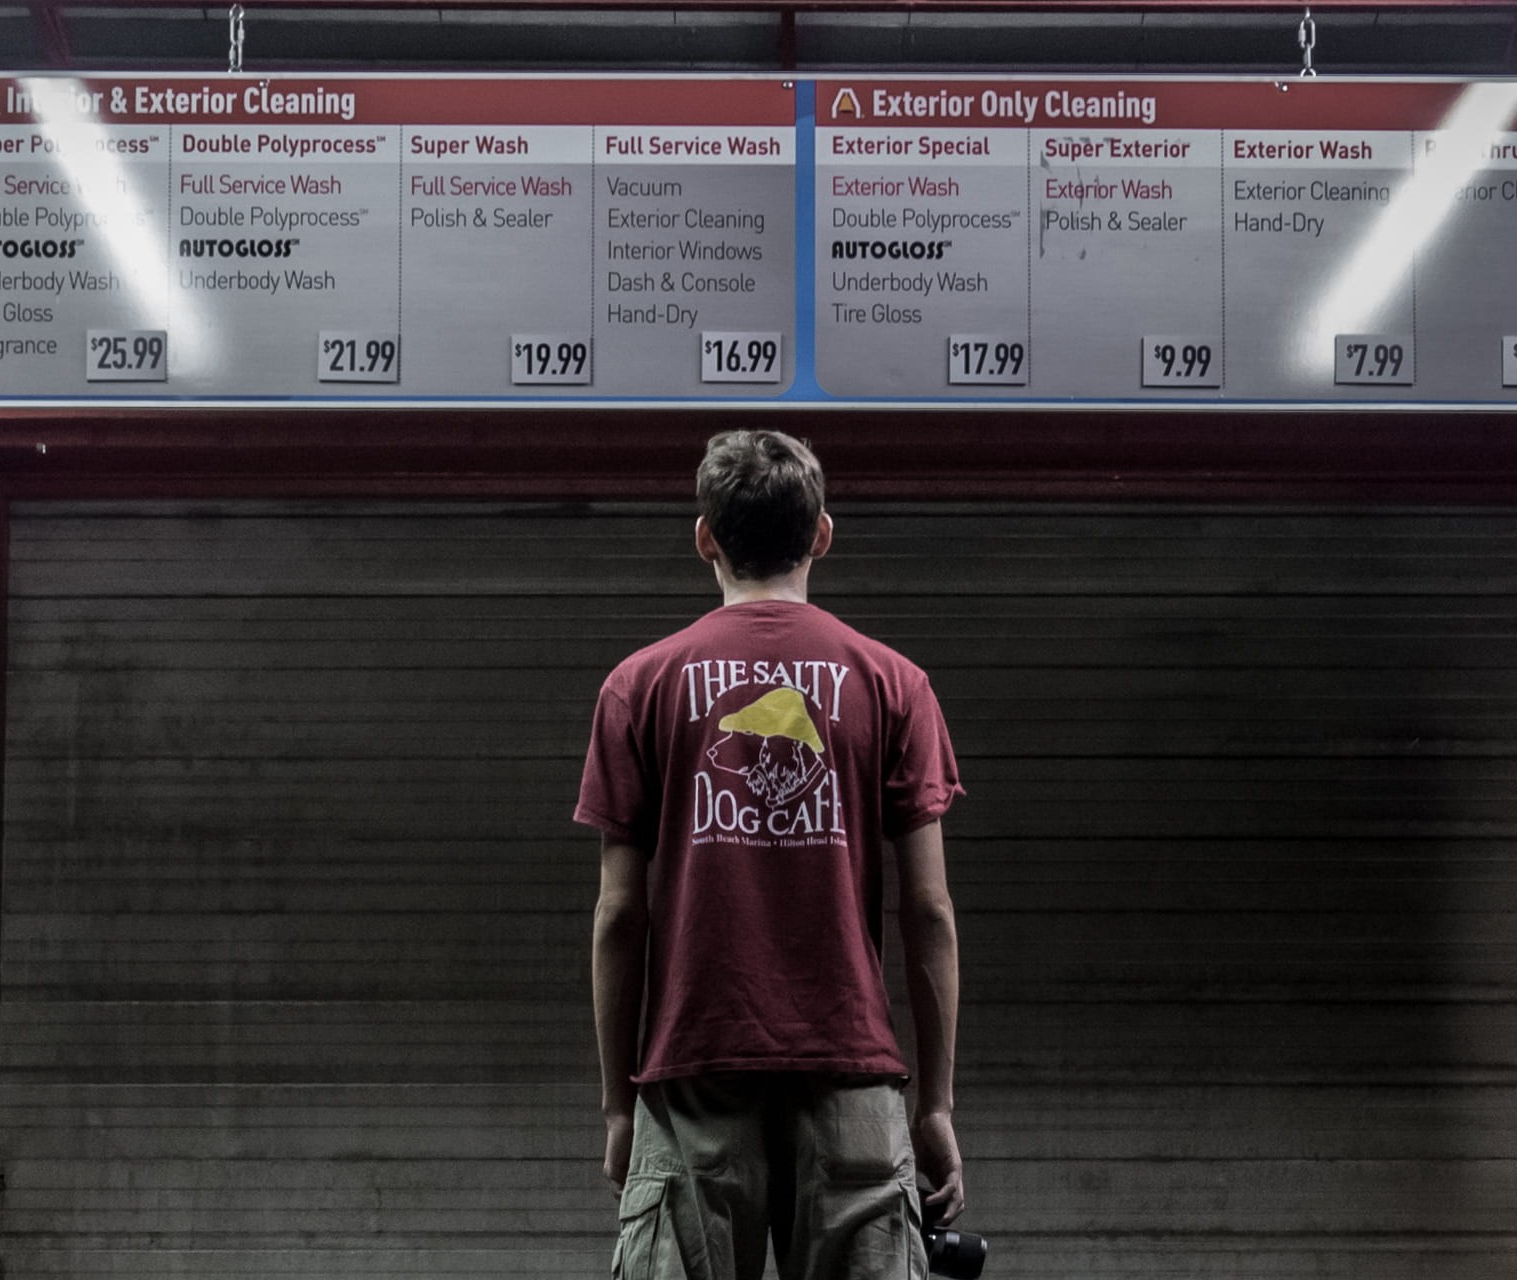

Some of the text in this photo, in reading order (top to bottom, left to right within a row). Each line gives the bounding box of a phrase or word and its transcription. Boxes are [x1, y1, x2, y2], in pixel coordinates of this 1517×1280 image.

[110, 89, 128, 114] &
[135, 88, 239, 114] Exterior
[244, 88, 355, 119] Cleaning
[873, 90, 1156, 124] Exterior Only Cleaning
[183, 135, 251, 153] Double
[411, 136, 528, 157] Super Wash
[606, 137, 780, 155] Full Service Wash
[832, 136, 990, 158] Exterior Special
[1045, 140, 1190, 161] Super Exterior
[1234, 140, 1372, 159] Exterior Wash
[4, 176, 70, 195] Service
[181, 175, 341, 193] Full Service Wash
[412, 176, 571, 196] Full Service Wash
[607, 178, 682, 196] Vacuum
[833, 177, 959, 196] Exterior Wash
[1046, 179, 1172, 199] Exterior Wash
[1235, 181, 1390, 204] Exterior Cleaning
[180, 207, 245, 225] Double
[412, 208, 552, 227] Polish & Sealer
[609, 209, 764, 233] Exterior Cleaning
[833, 209, 896, 227] Double
[1046, 211, 1187, 231] Polish & Sealer
[1235, 212, 1324, 237] Hand-Dry
[609, 241, 762, 260] Interior Windows
[70, 272, 119, 290] Wash
[180, 271, 335, 294] Underbody Wash
[609, 273, 755, 292] Dash & Console
[833, 272, 988, 295] Underbody Wash
[3, 303, 53, 321] Gloss
[609, 305, 697, 327] Hand-Dry
[833, 304, 922, 323] Tire Gloss
[92, 337, 163, 368] $25.99
[324, 340, 394, 371] $21.99
[516, 344, 586, 375] $19.99
[706, 341, 776, 372] $16.99
[953, 343, 1023, 374] $17.99
[1155, 345, 1211, 377] $9.99
[1347, 345, 1403, 376] $7.99
[682, 660, 849, 722] THE SALTY
[693, 772, 760, 834] DOG
[741, 836, 771, 847] Marina
